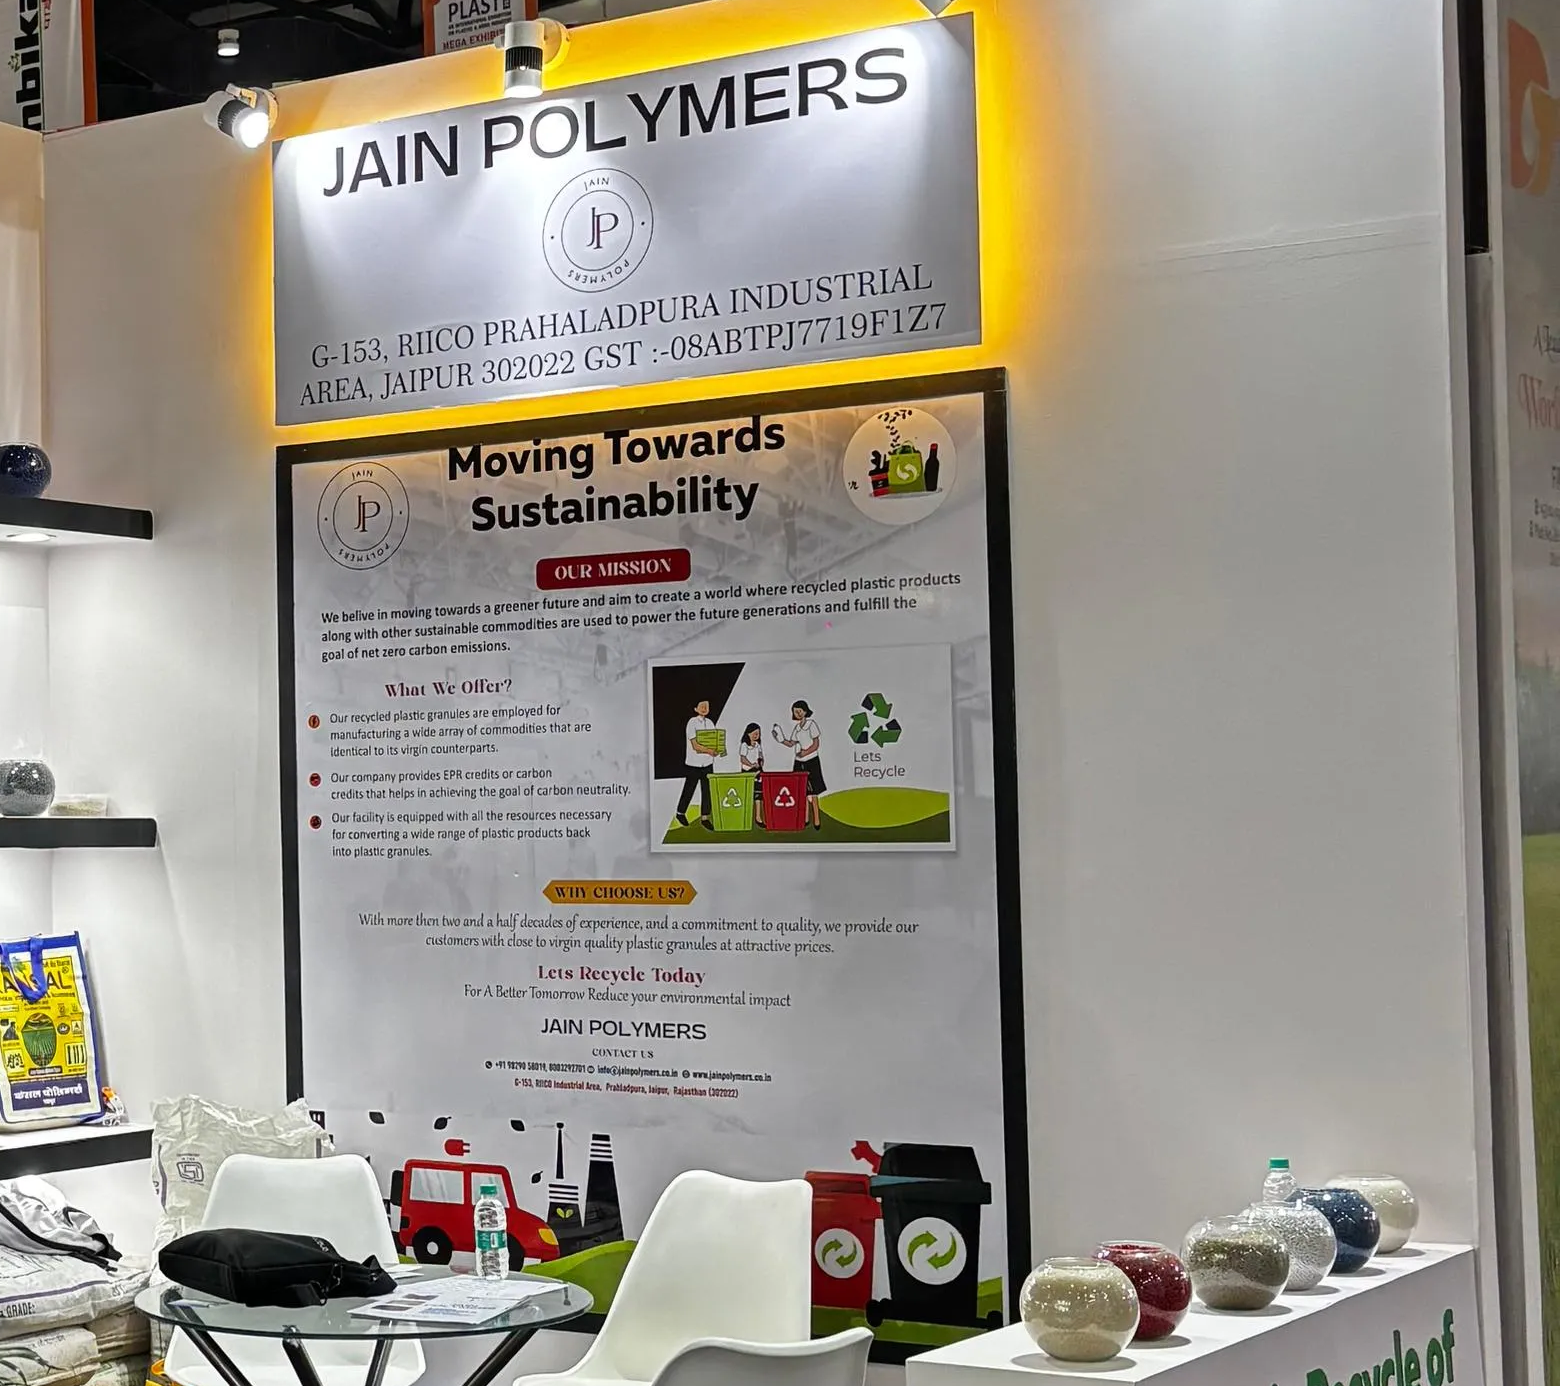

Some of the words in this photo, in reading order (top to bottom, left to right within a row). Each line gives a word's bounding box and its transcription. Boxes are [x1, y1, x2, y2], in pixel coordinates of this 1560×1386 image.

[322, 125, 460, 198] JAIN
[483, 47, 908, 170] POLYMERS
[583, 175, 612, 192] JAIN
[566, 257, 632, 287] POLYMERS
[311, 337, 390, 370] G-153,
[398, 324, 475, 360] RIICO
[483, 292, 719, 349] PRAHALADPURA
[729, 262, 933, 316] INDUSTRIAL
[299, 374, 375, 407] AREA,
[380, 364, 473, 401] JAIPUR
[481, 351, 576, 385] 302022
[584, 340, 643, 372] GST
[447, 439, 594, 482] Moving
[604, 415, 786, 467] Towards
[470, 476, 760, 533] Sustainability
[553, 561, 594, 581] OUR
[597, 556, 672, 579] MISSION
[321, 612, 340, 624] We
[341, 610, 375, 623] belive
[377, 608, 388, 620] in
[391, 606, 432, 621] moving
[435, 602, 481, 616] towards
[484, 603, 491, 613] a
[494, 600, 539, 616] greener
[543, 596, 579, 610] future
[582, 595, 605, 607] and
[609, 593, 631, 605] aim
[635, 593, 648, 604] to
[651, 589, 690, 604] create
[694, 590, 701, 600] a
[705, 585, 742, 600] world
[746, 582, 787, 597] where
[791, 580, 847, 596] recycled
[851, 574, 895, 592] plastic
[899, 573, 961, 589] products
[385, 682, 426, 698] What
[432, 681, 456, 696] We
[462, 678, 512, 694] Offer?
[852, 749, 882, 765] Lets
[853, 762, 906, 780] Recycle
[554, 886, 588, 899] WHY
[593, 886, 653, 900] CHOOSE
[657, 886, 685, 899] US?
[539, 965, 574, 981] Lets
[580, 966, 645, 985] Recycle
[652, 967, 705, 987] Today
[541, 1017, 583, 1035] JAIN
[589, 1019, 707, 1040] POLYMERS
[7, 1302, 36, 1318] GRADE:
